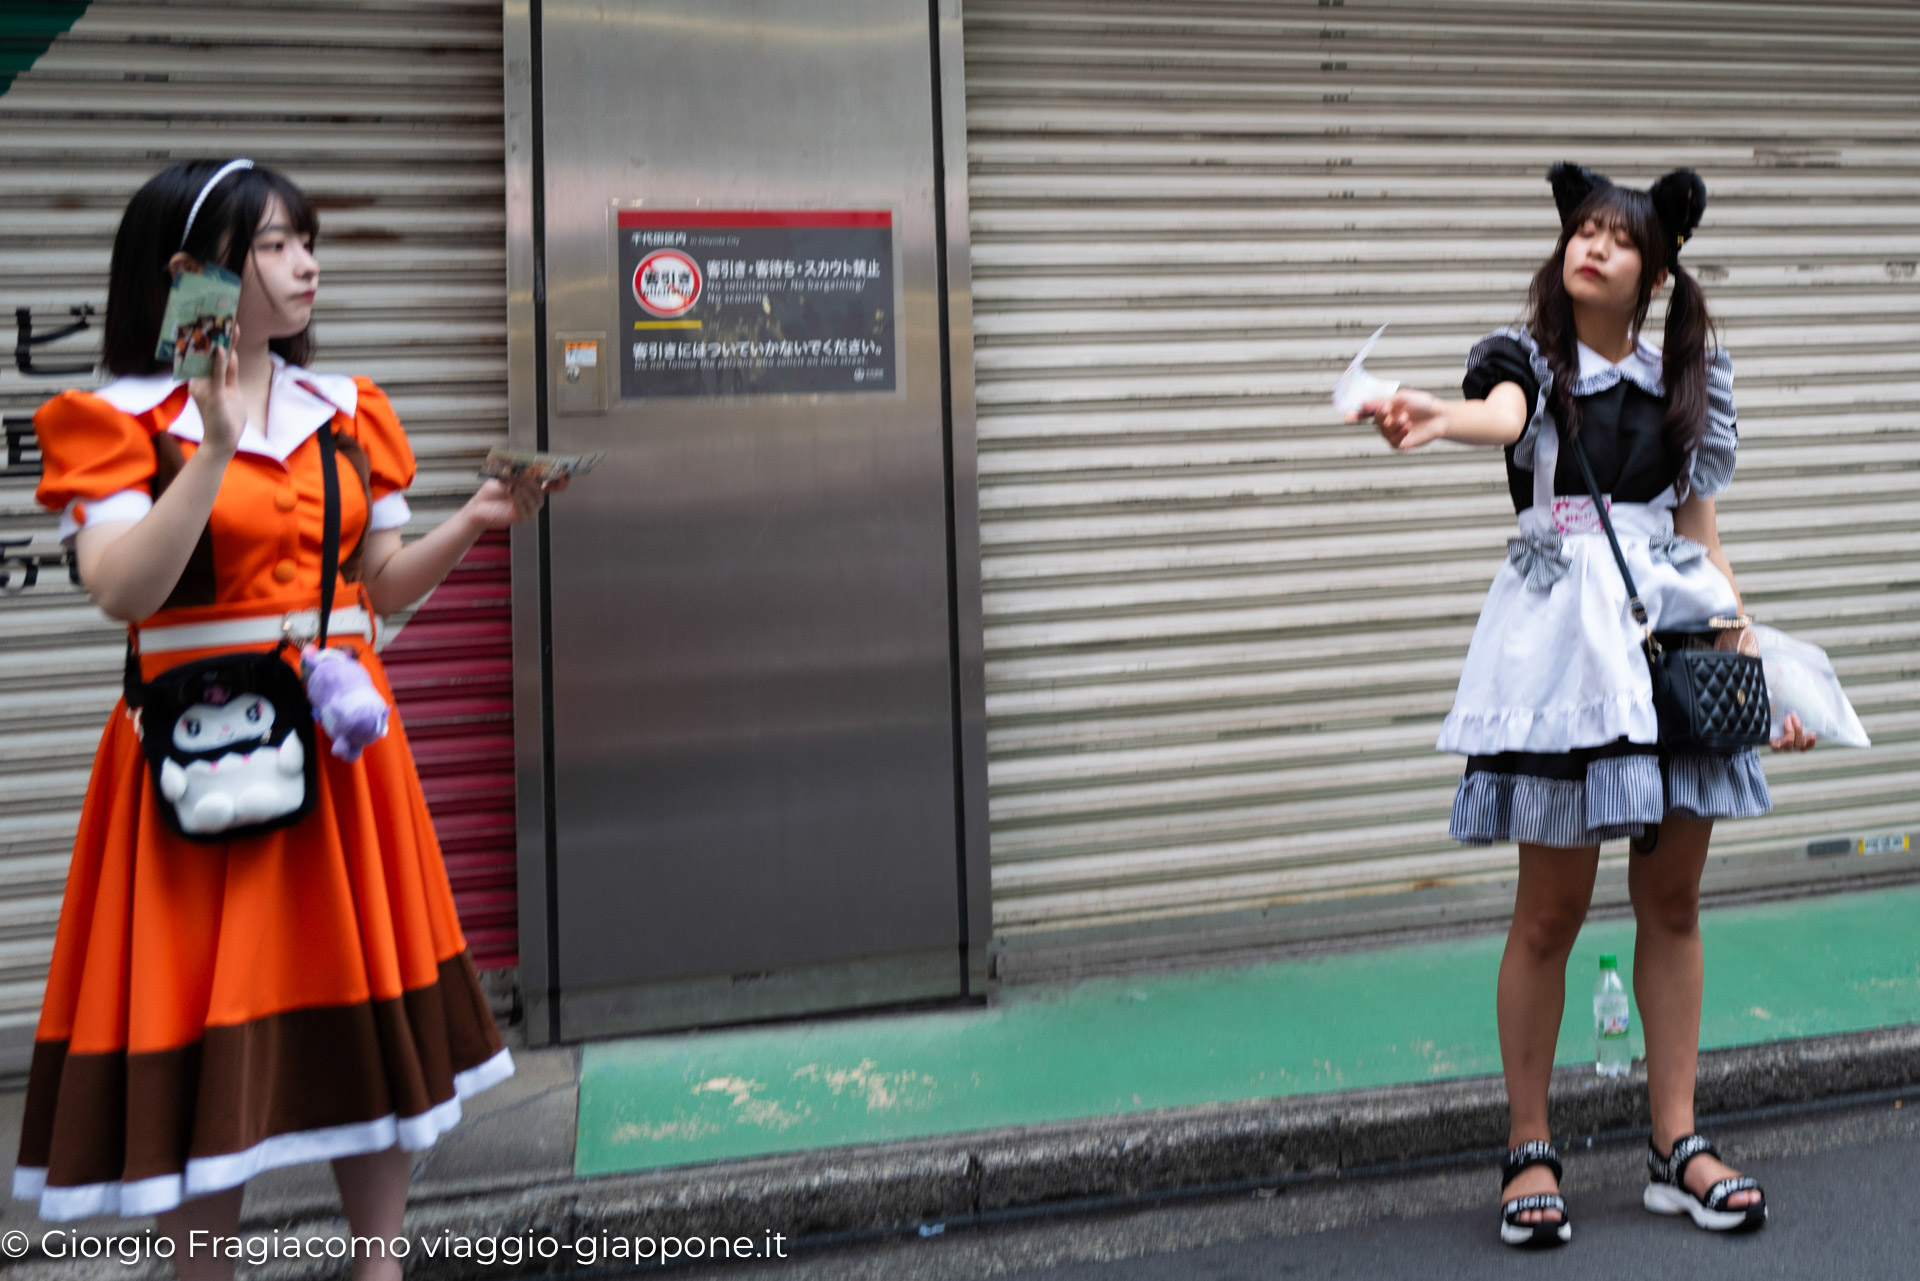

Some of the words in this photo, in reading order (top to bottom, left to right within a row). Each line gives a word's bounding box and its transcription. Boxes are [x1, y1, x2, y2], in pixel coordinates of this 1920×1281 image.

[631, 231, 687, 247] 千代田区内
[707, 279, 720, 292] No
[790, 278, 804, 292] No
[707, 292, 721, 305] No
